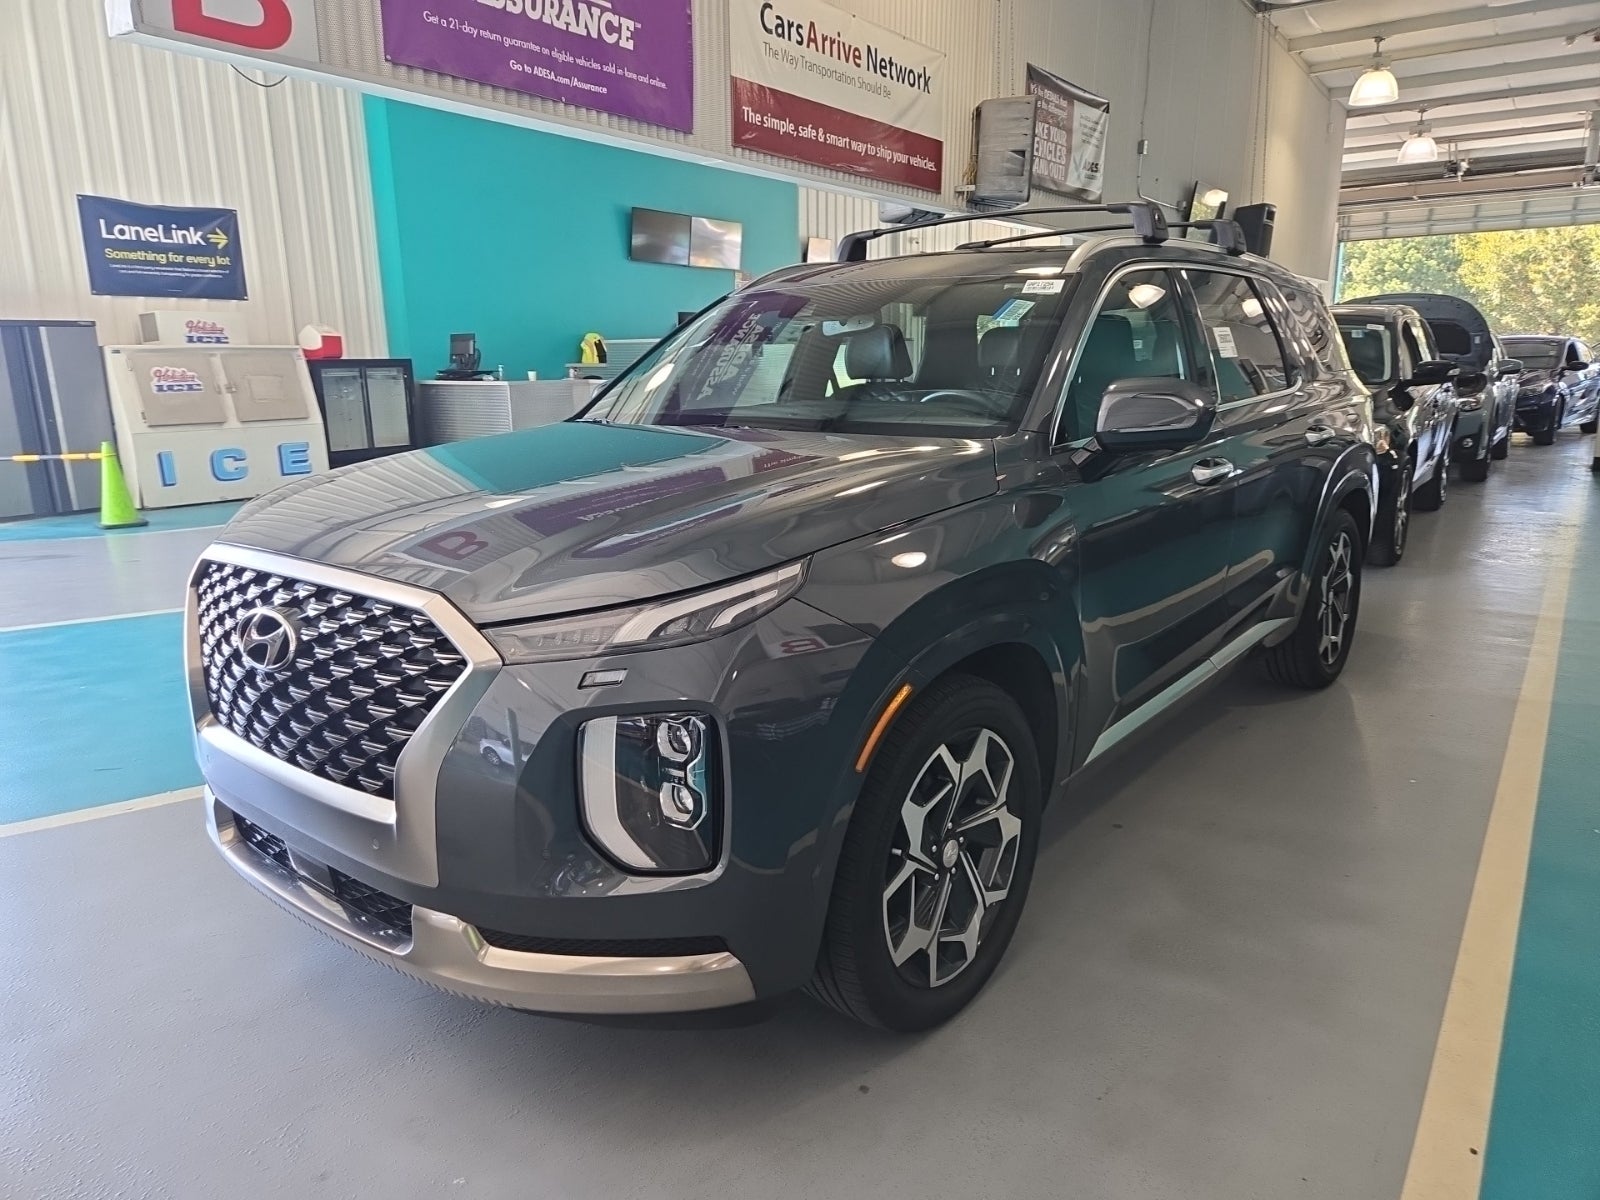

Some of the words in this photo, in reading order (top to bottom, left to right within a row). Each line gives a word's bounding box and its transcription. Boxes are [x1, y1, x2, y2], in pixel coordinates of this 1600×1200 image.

[423, 10, 439, 24] Get
[441, 18, 447, 27] a
[449, 17, 478, 38] 21-day
[480, 29, 502, 42] return
[503, 36, 541, 52] guarantee
[541, 47, 550, 56] on
[551, 47, 574, 63] eligible
[575, 55, 601, 70] vehicles
[602, 62, 616, 74] sold
[638, 74, 649, 83] and
[509, 59, 523, 71] Go
[524, 64, 532, 74] to
[533, 65, 608, 94] ADESA.com/Assurance
[763, 41, 780, 60] The
[781, 48, 800, 70] Way
[800, 55, 857, 88] Transportation
[858, 76, 882, 96] Should
[883, 85, 892, 100] Be
[866, 44, 931, 94] Network
[742, 106, 761, 125] The
[763, 113, 797, 137] simple,
[799, 124, 817, 140] safe
[818, 127, 825, 143] &
[826, 133, 849, 151] smart
[850, 139, 867, 156] way
[867, 143, 876, 156] to
[876, 144, 892, 162] ship
[892, 151, 909, 164] your
[909, 154, 937, 172] vehicles.
[1050, 125, 1067, 147] YOUR
[99, 218, 207, 246] LaneLink
[104, 248, 167, 264] Something
[168, 252, 184, 263] for
[186, 255, 216, 267] every
[216, 256, 231, 265] lot
[185, 335, 230, 344] ICE
[154, 383, 203, 392] ICE
[157, 441, 313, 487] ICE
